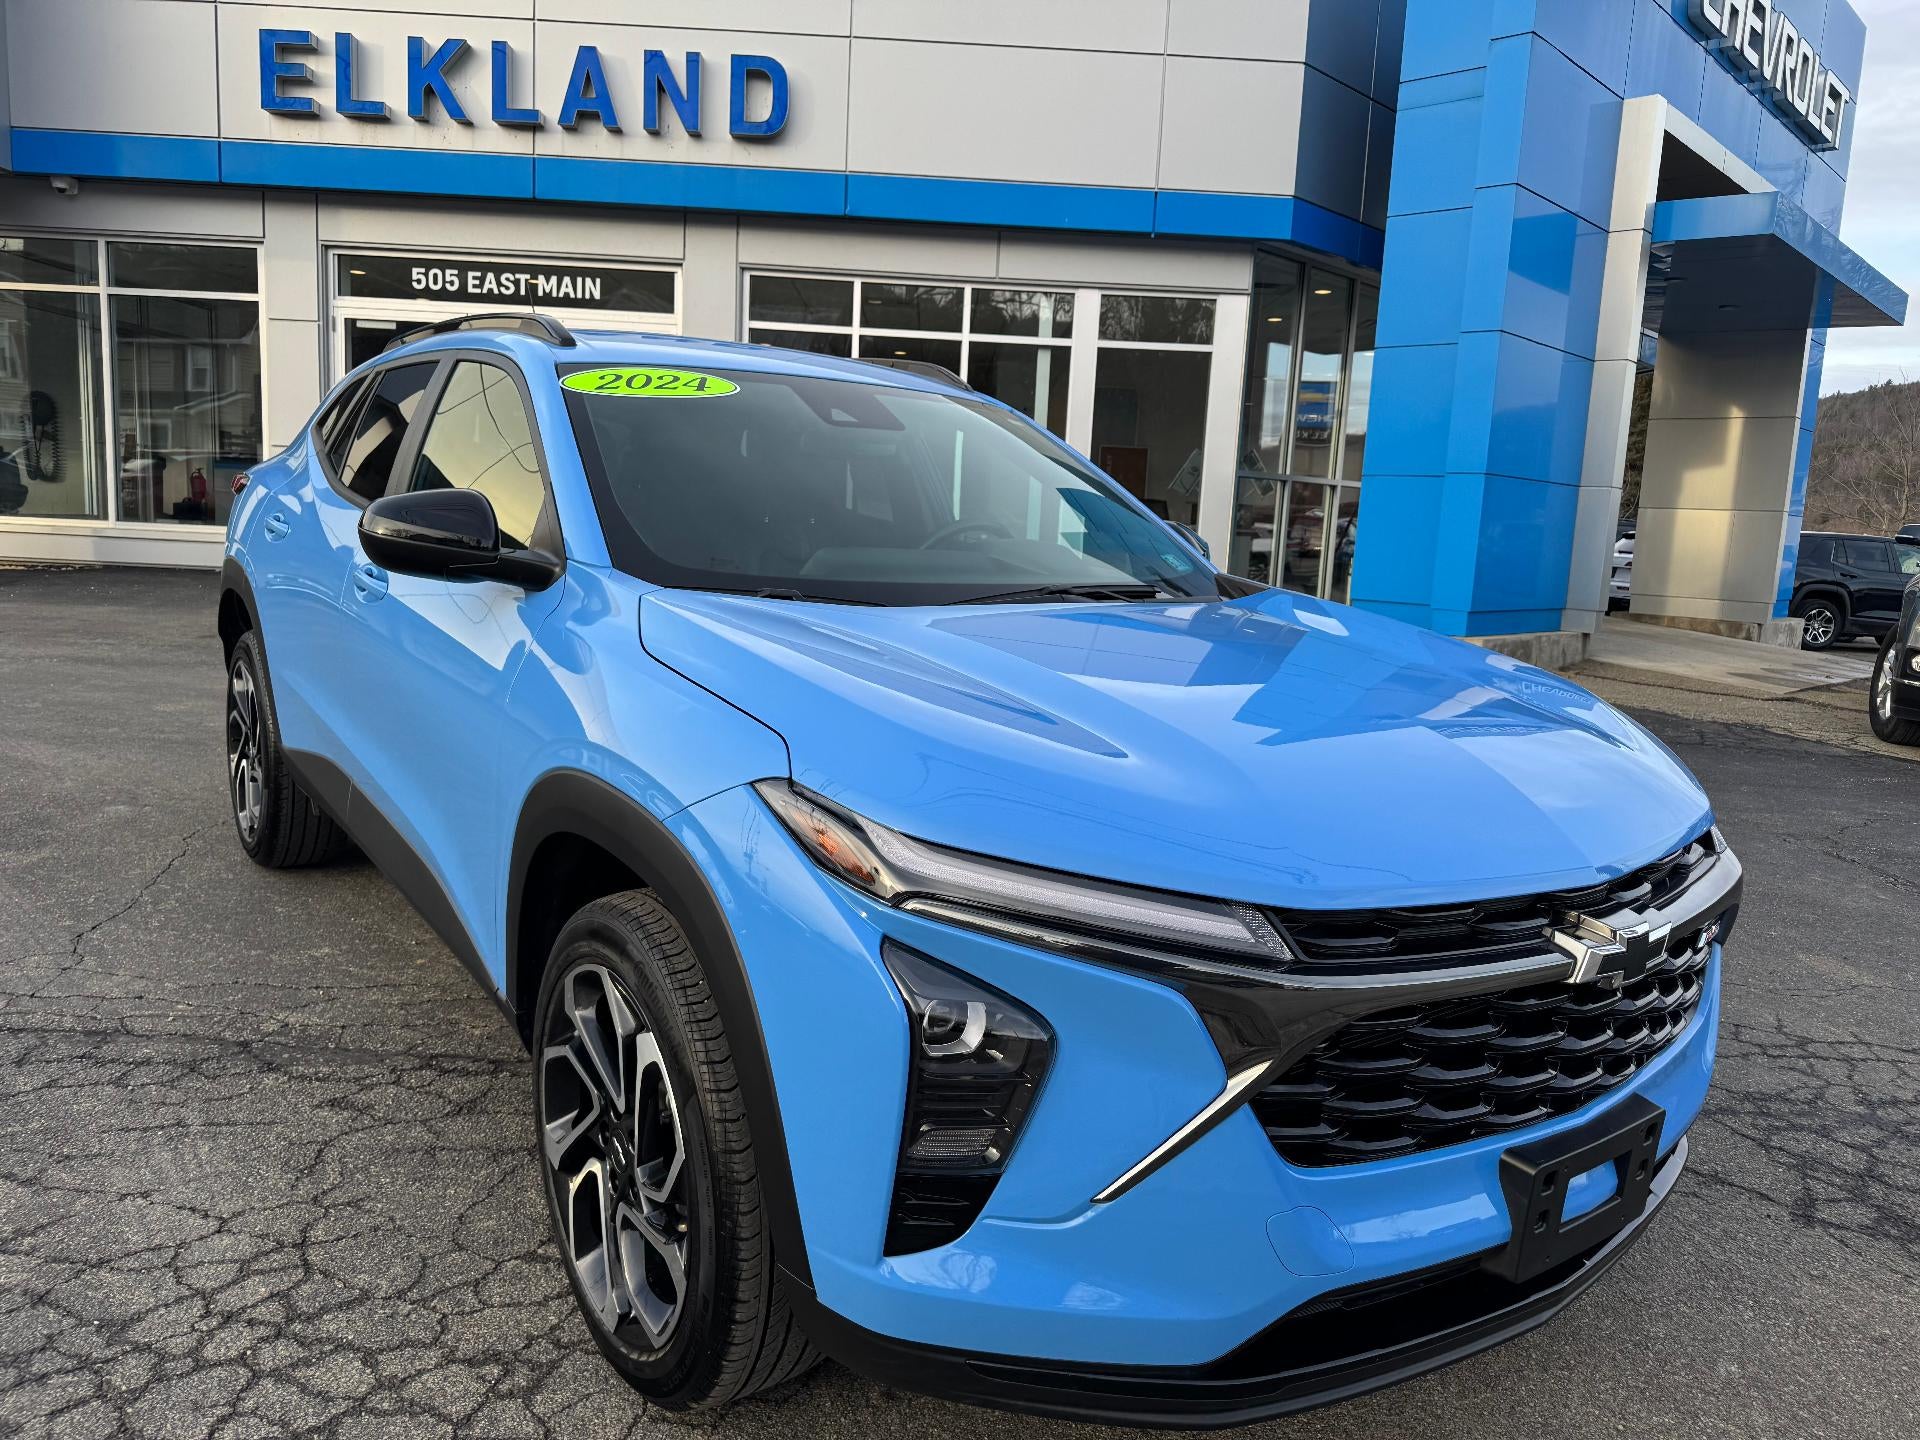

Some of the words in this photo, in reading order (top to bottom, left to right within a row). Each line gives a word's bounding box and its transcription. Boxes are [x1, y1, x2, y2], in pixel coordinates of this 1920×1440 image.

[258, 28, 791, 139] ELKLAND
[411, 266, 460, 292] 505
[466, 270, 531, 296] EAST
[537, 274, 601, 300] MAIN
[594, 372, 712, 393] 2024
